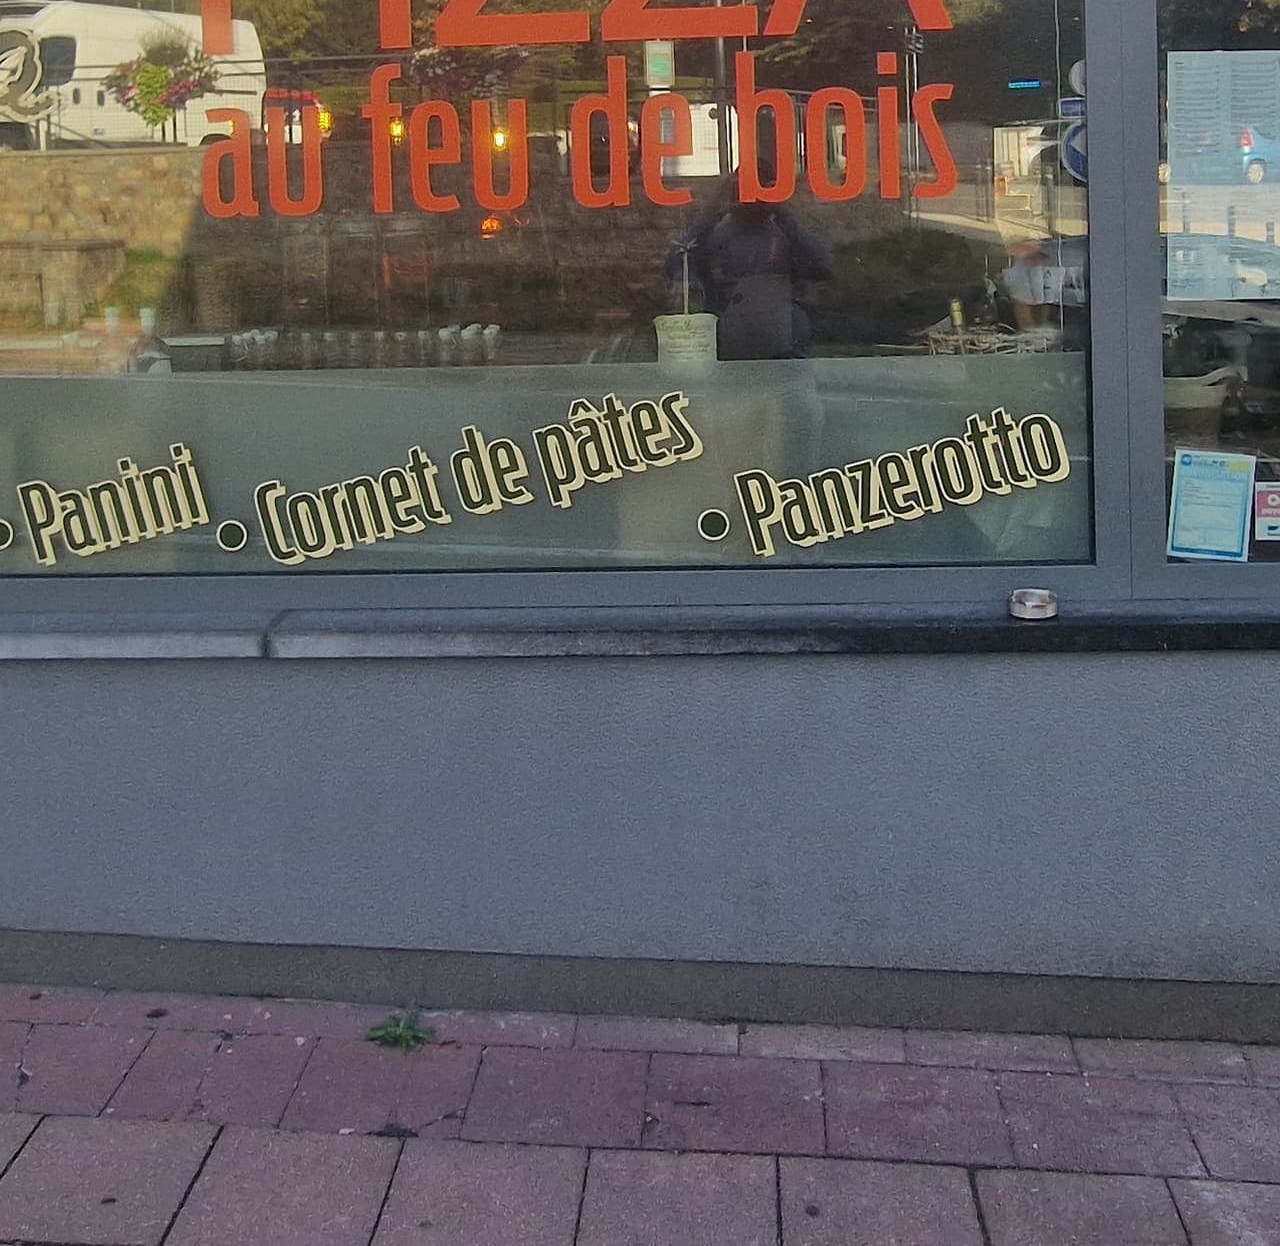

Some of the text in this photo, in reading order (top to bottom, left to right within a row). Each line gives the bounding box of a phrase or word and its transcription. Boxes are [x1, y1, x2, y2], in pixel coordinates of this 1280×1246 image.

[202, 50, 959, 218] au feu de bois
[17, 442, 210, 566] Panini
[254, 390, 704, 565] Cornet de pâtes
[733, 405, 1071, 557] Panzerotto
